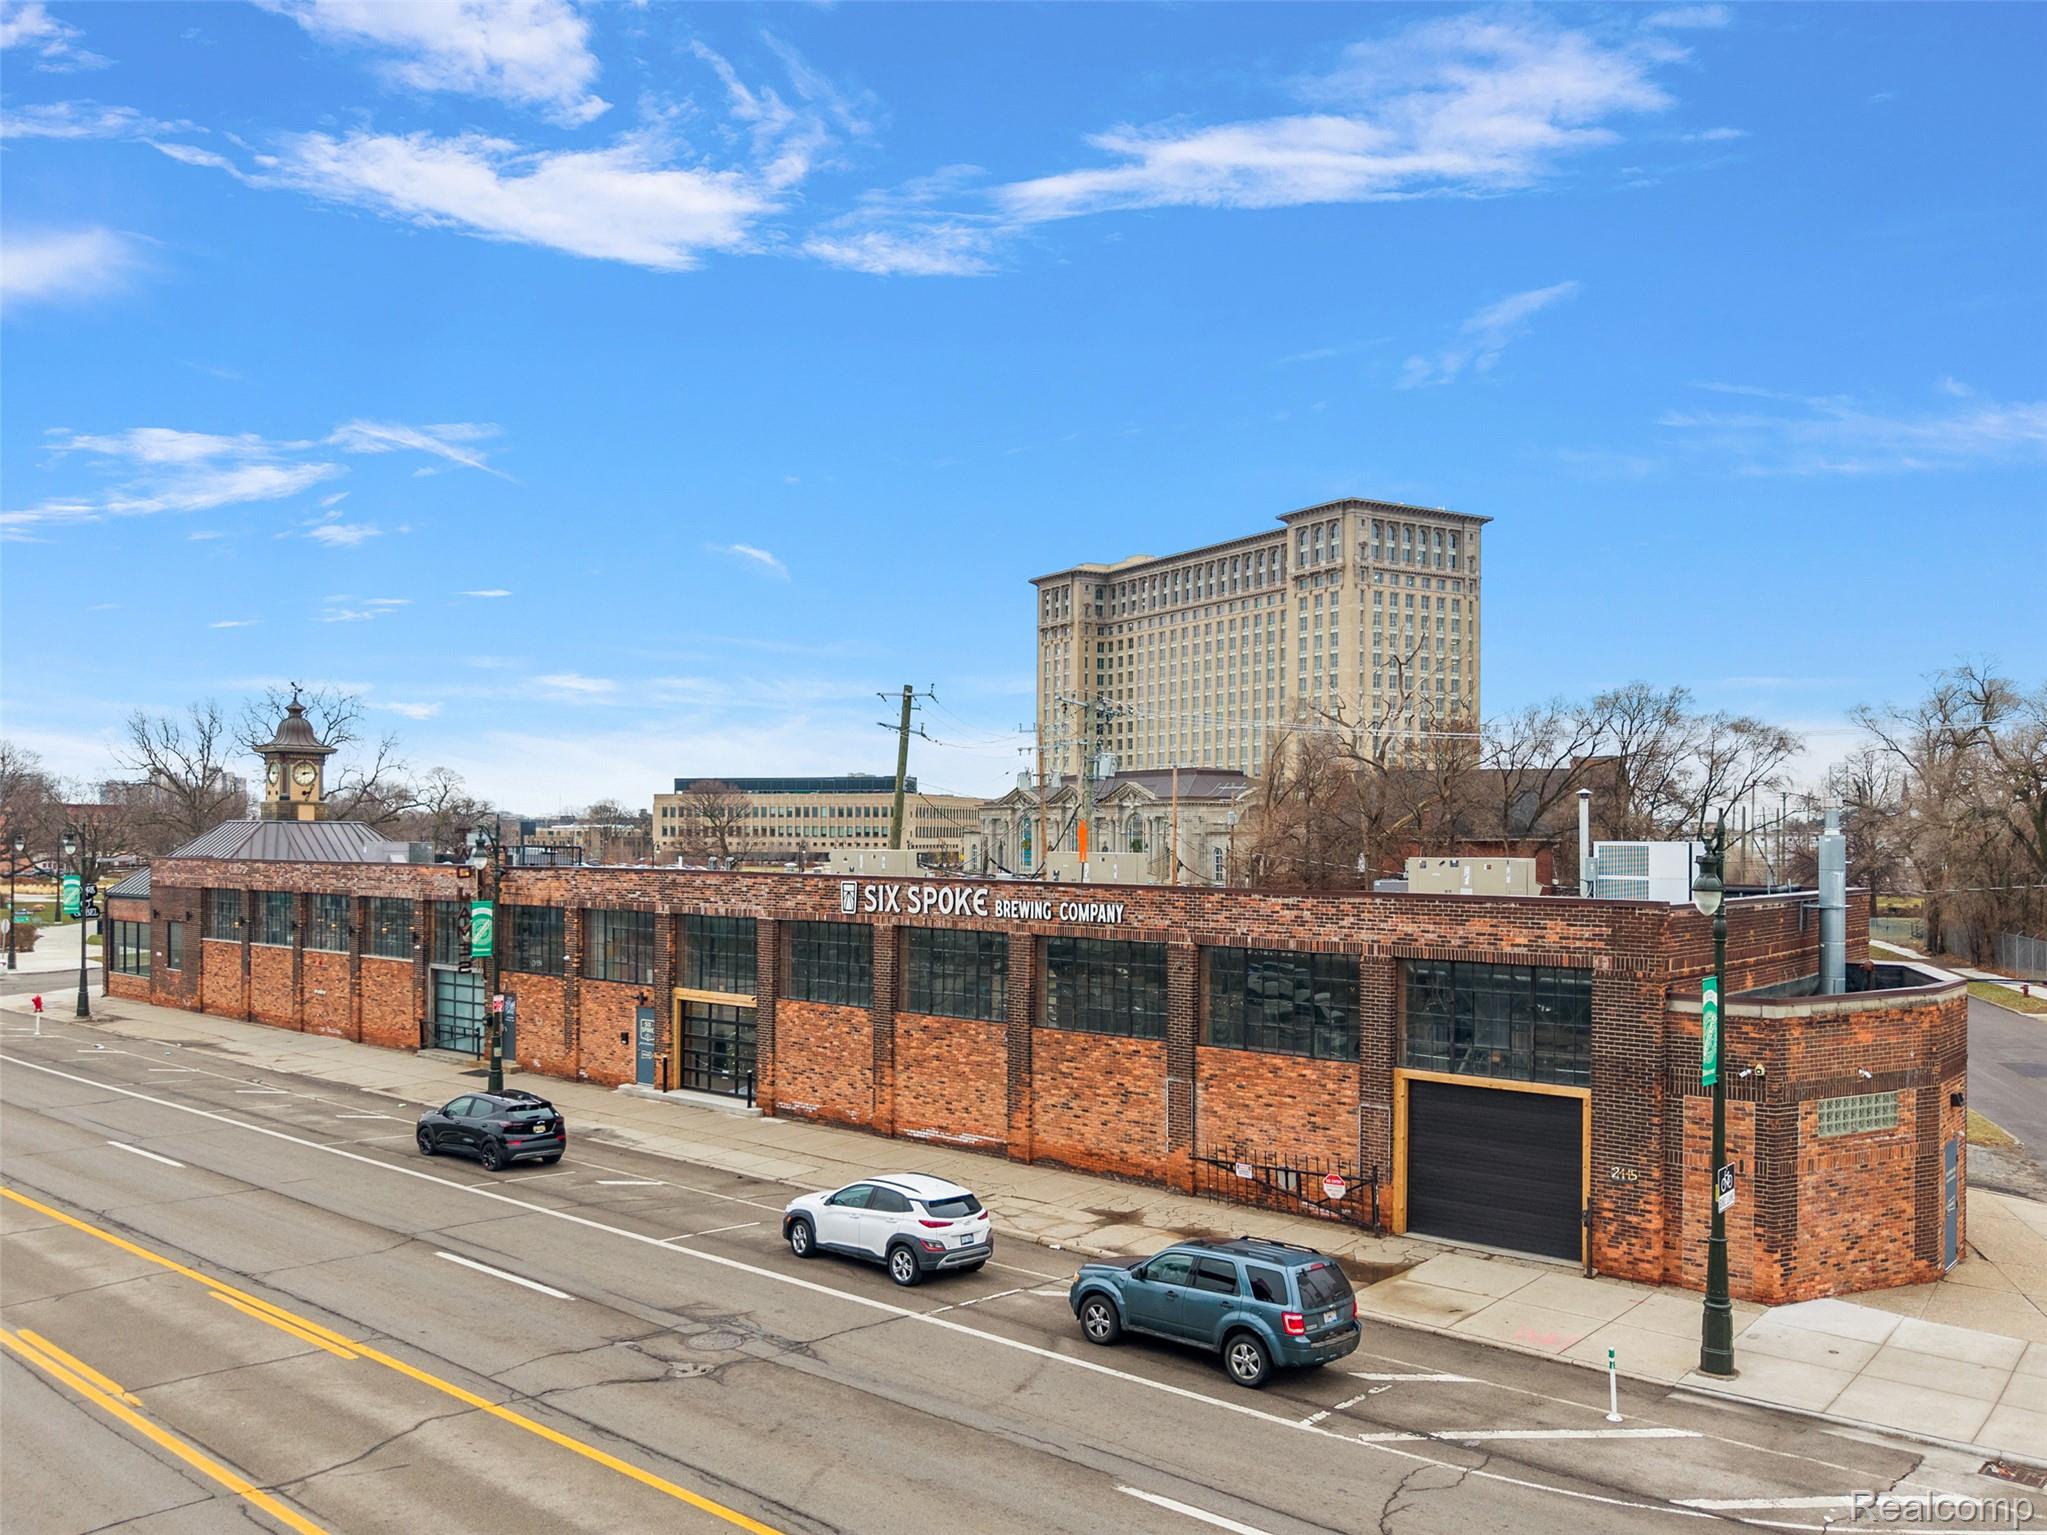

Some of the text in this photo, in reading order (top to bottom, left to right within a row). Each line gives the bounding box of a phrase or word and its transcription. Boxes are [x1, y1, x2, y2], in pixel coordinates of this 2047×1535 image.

[864, 884, 1124, 923] SIX SPOKE BREWING COMPANY
